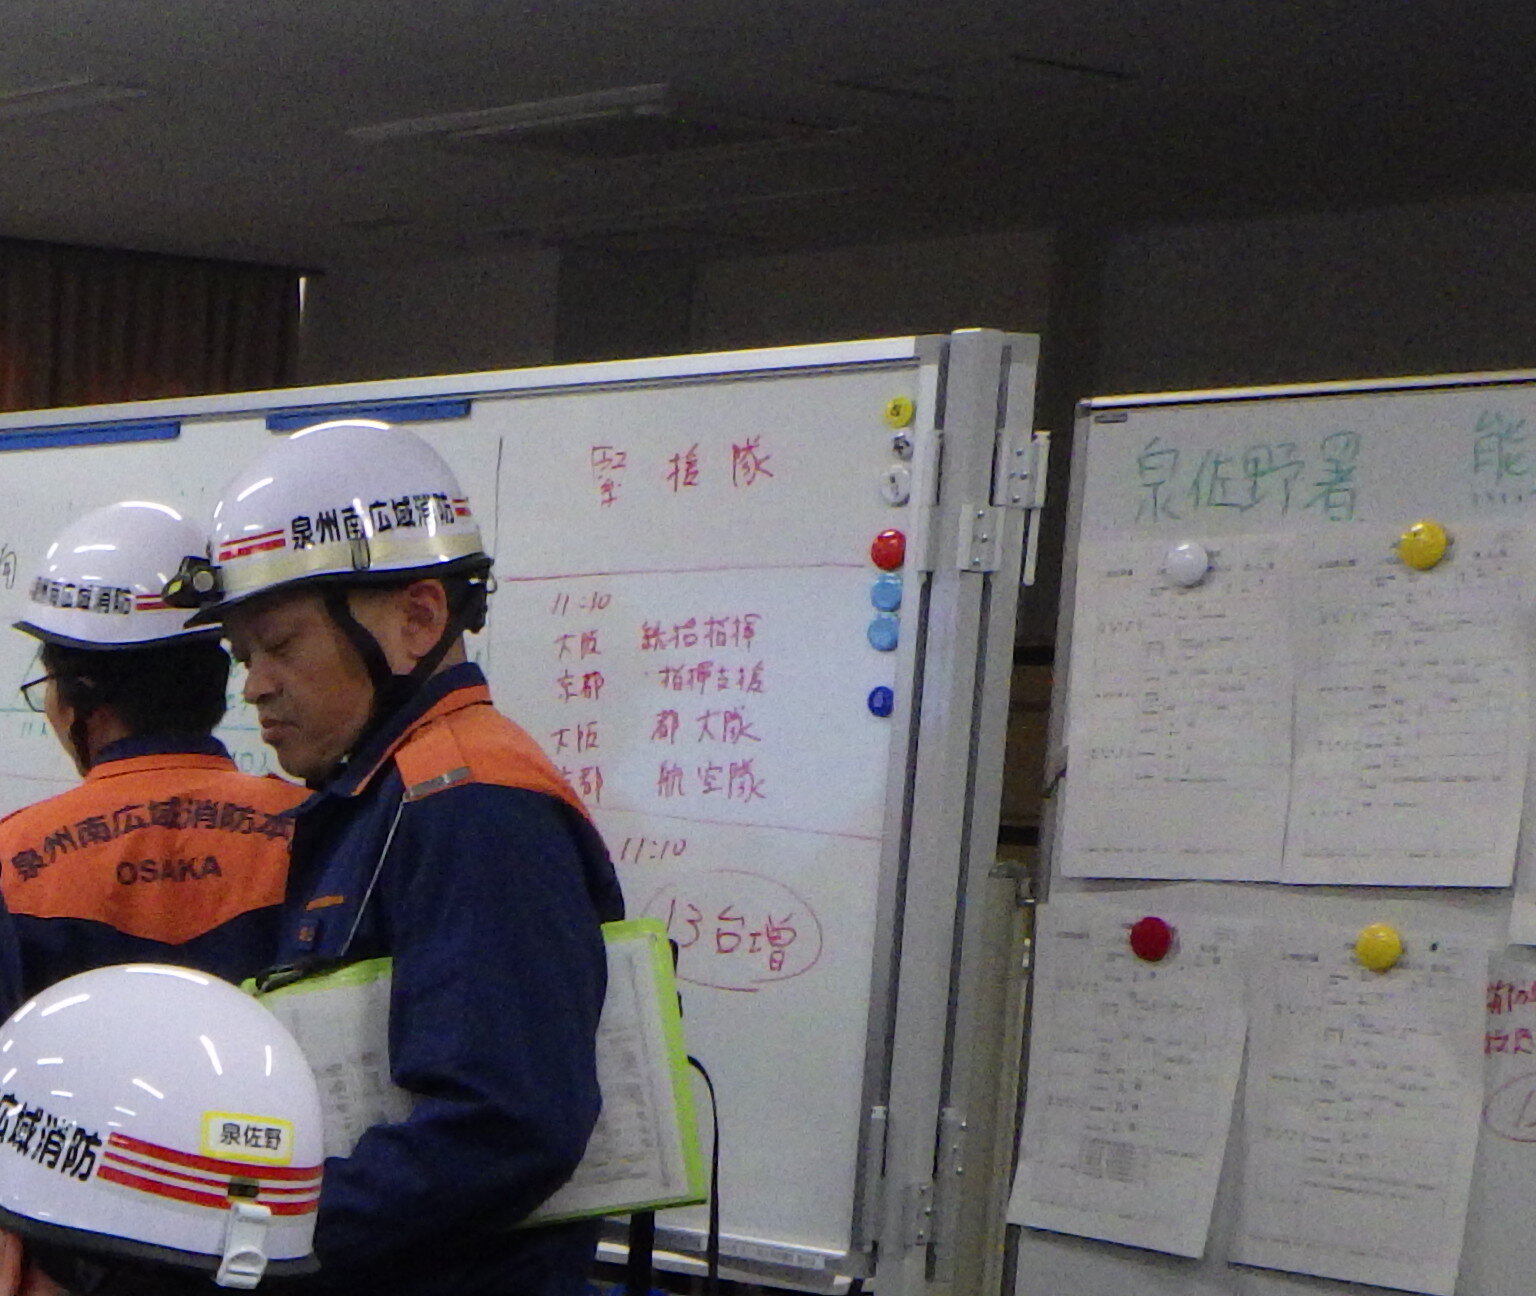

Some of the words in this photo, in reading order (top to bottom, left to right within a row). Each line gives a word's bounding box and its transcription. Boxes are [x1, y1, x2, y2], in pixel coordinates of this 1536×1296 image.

[1134, 434, 1363, 523] 泉佐野署
[291, 491, 456, 550] 泉州南広域消防
[552, 592, 612, 616] 11:10
[116, 855, 223, 885] OSAKA
[220, 1122, 282, 1151] 泉佐野
